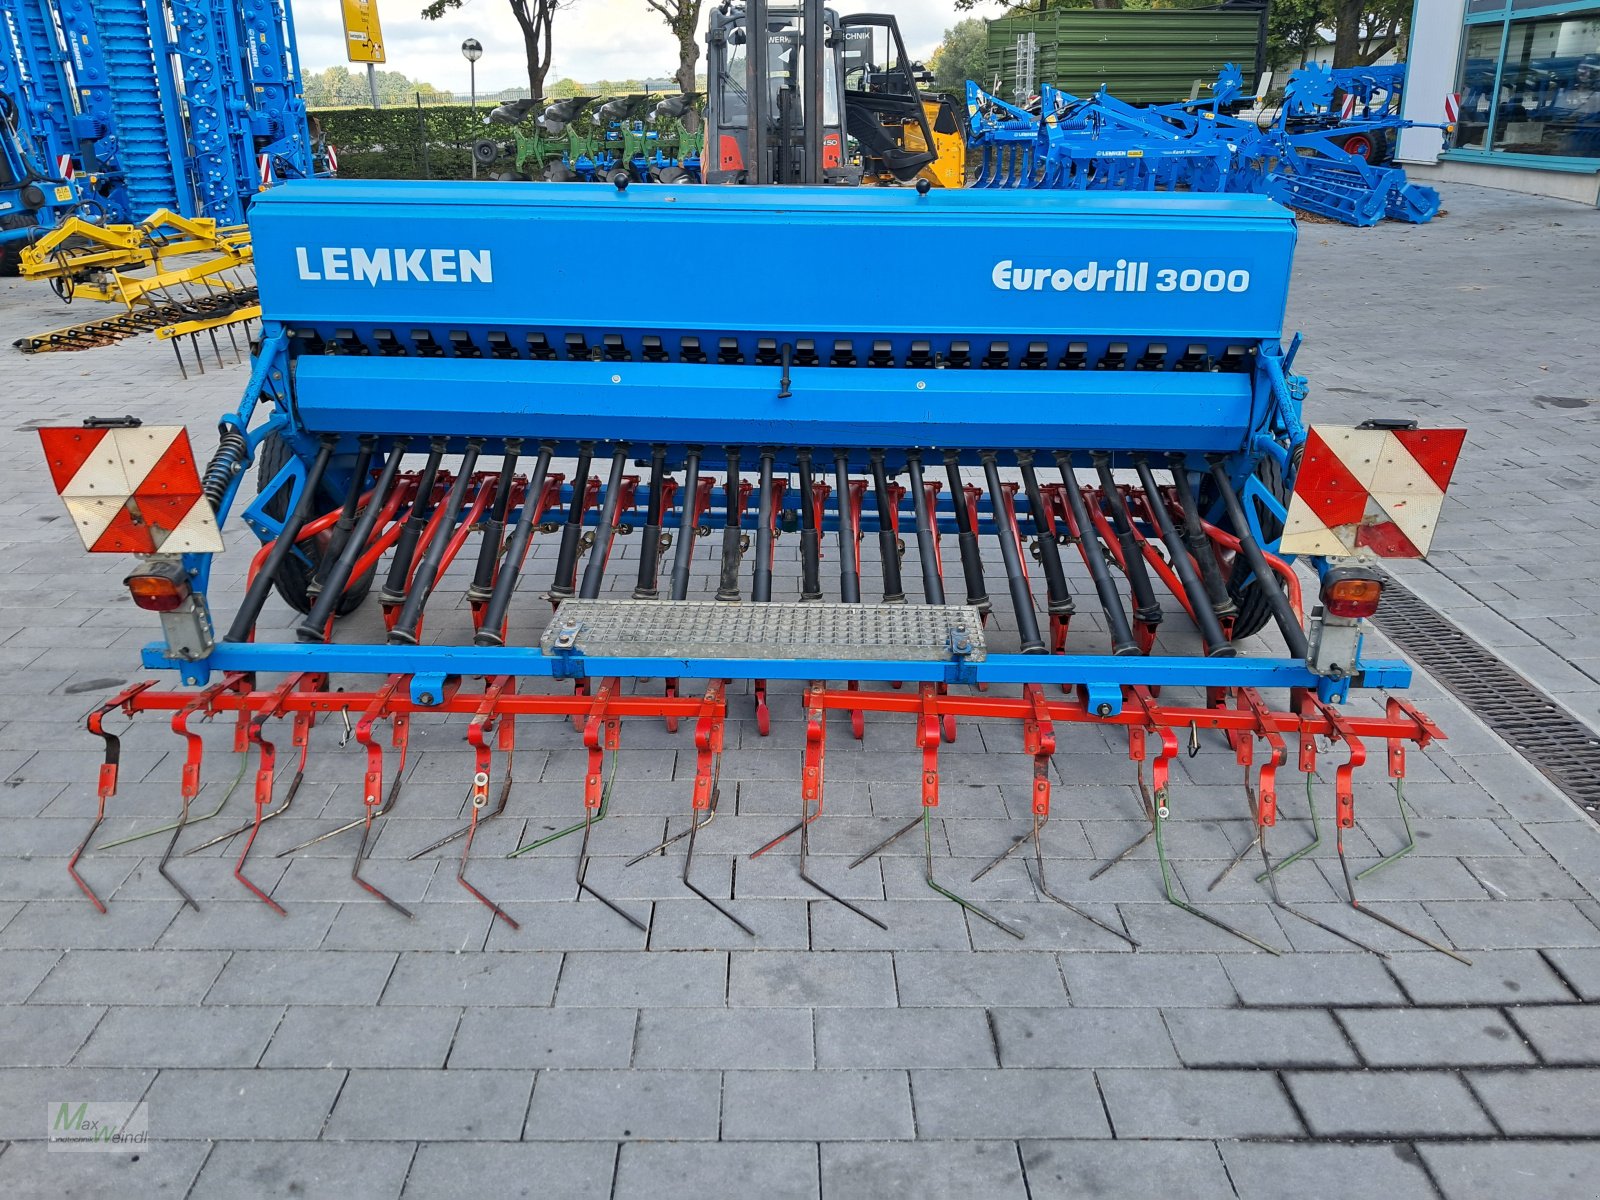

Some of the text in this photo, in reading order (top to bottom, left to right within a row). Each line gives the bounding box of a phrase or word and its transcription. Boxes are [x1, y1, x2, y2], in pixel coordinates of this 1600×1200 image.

[296, 247, 493, 288] LEMKEN
[992, 259, 1250, 293] Eurodrill 3000
